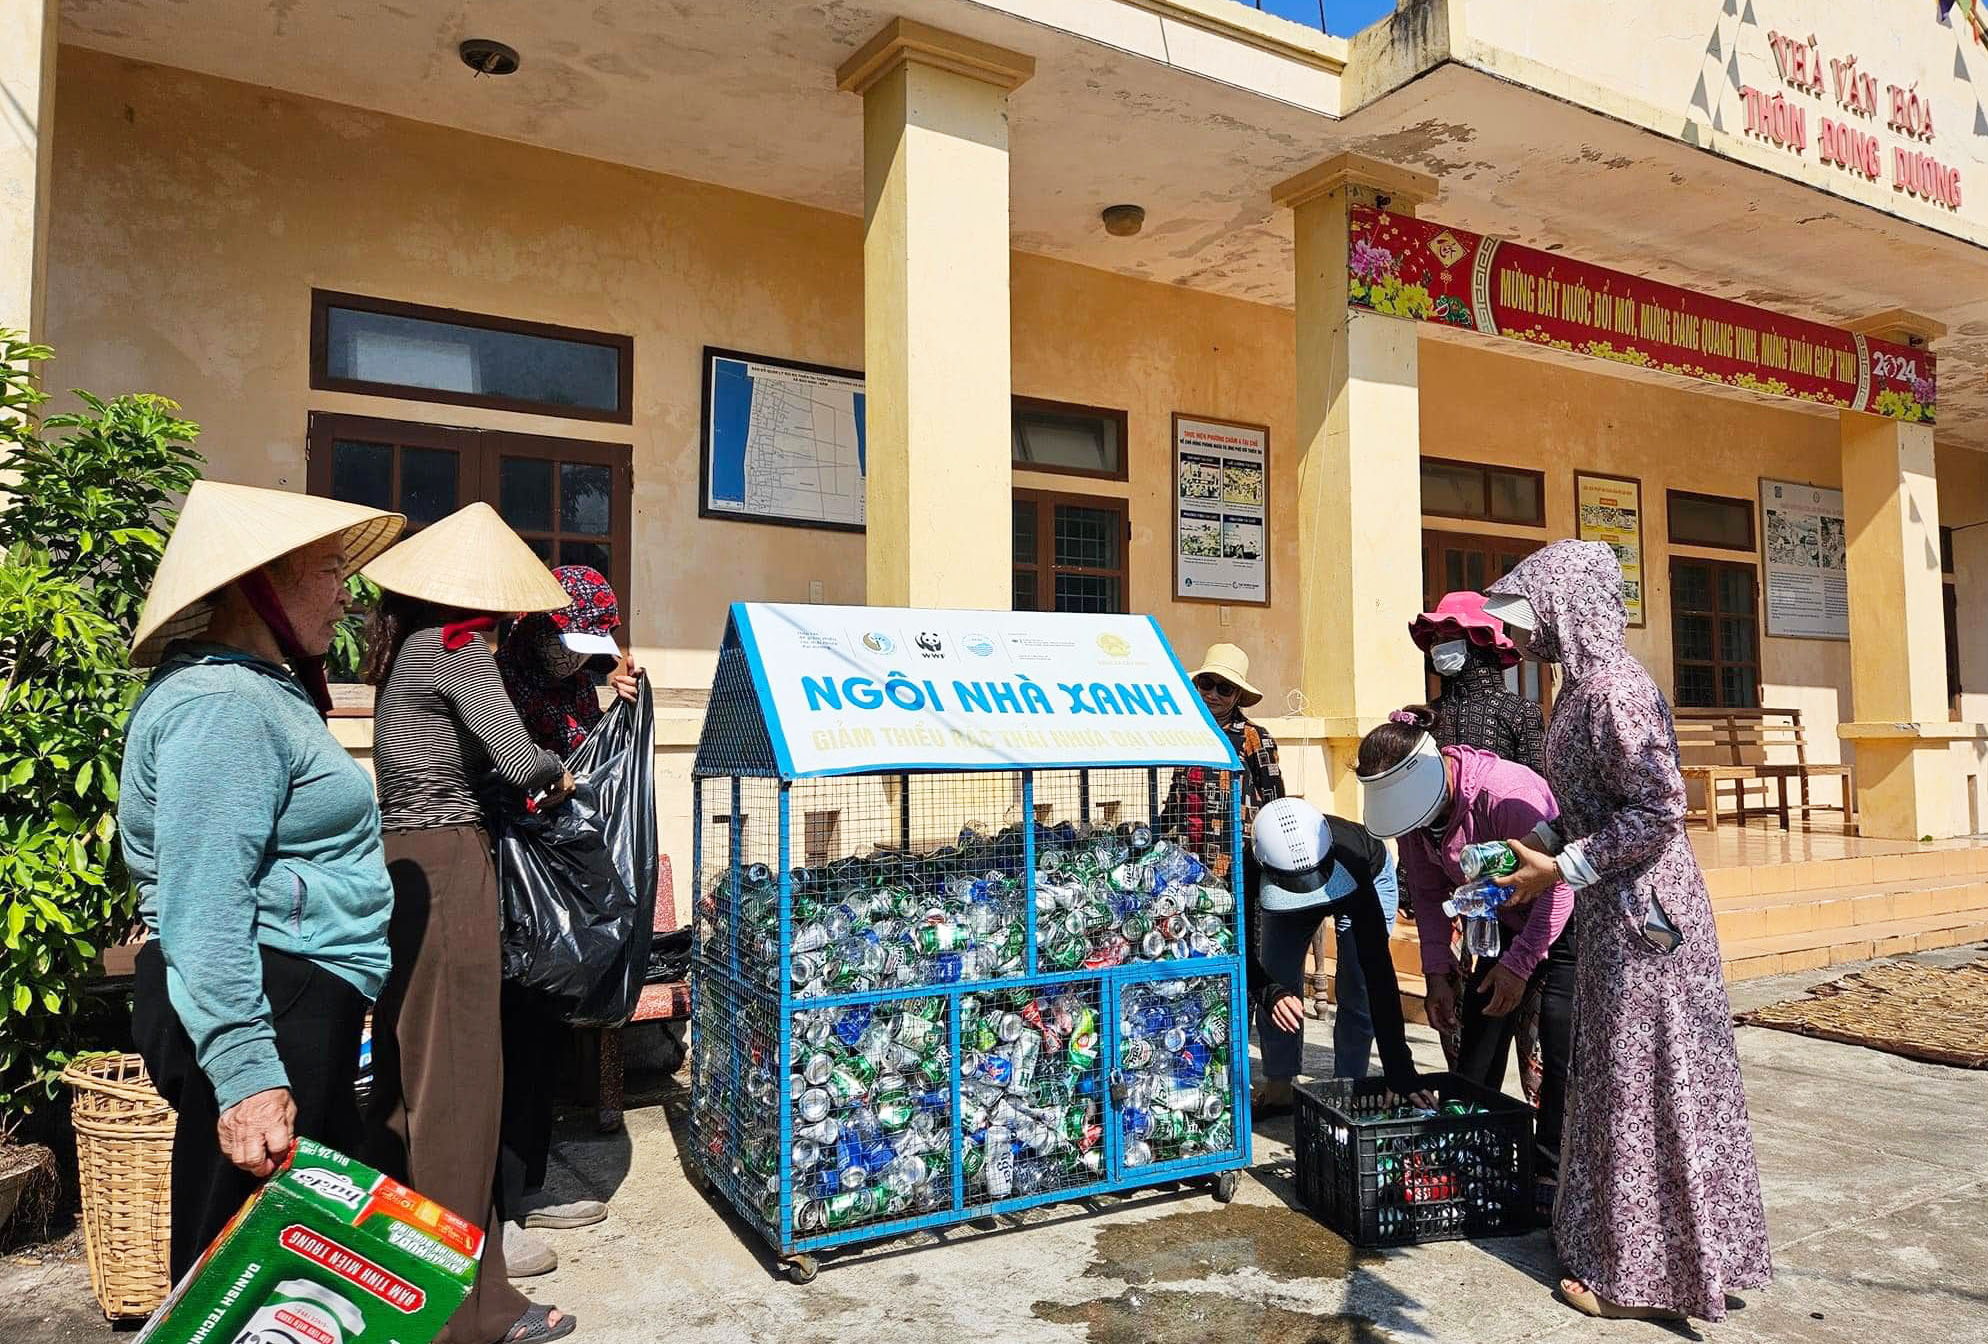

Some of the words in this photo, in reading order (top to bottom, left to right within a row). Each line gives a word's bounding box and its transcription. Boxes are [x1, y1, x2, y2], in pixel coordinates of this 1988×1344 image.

[1738, 85, 1806, 150] THÔN
[1886, 81, 1935, 139] HÓA
[1500, 261, 1535, 312] MỪNG
[1538, 266, 1559, 319] ĐẤT
[1562, 276, 1592, 326] NƯỚC
[1594, 279, 1612, 331] ĐỔI
[1615, 288, 1638, 341] MỚI,
[1640, 296, 1670, 344] MỪNG
[1672, 297, 1699, 350] ĐẢNG
[1702, 318, 1733, 358] QUANG
[1736, 325, 1758, 368] VINH,
[1761, 326, 1787, 369] MỪNG
[1789, 335, 1812, 375] XUÂN
[1815, 340, 1834, 379] GIÁP
[1872, 351, 1917, 383] 2024
[801, 671, 945, 711] NGÔI
[952, 673, 1055, 714] NHÀ
[1057, 682, 1182, 715] XANH
[812, 719, 876, 751] GIẢM
[880, 720, 946, 748] THIỂU
[332, 1152, 350, 1167] BIA
[288, 1231, 331, 1259] TRUNG
[389, 1232, 428, 1257] HUDA
[220, 1263, 261, 1307] DANISH
